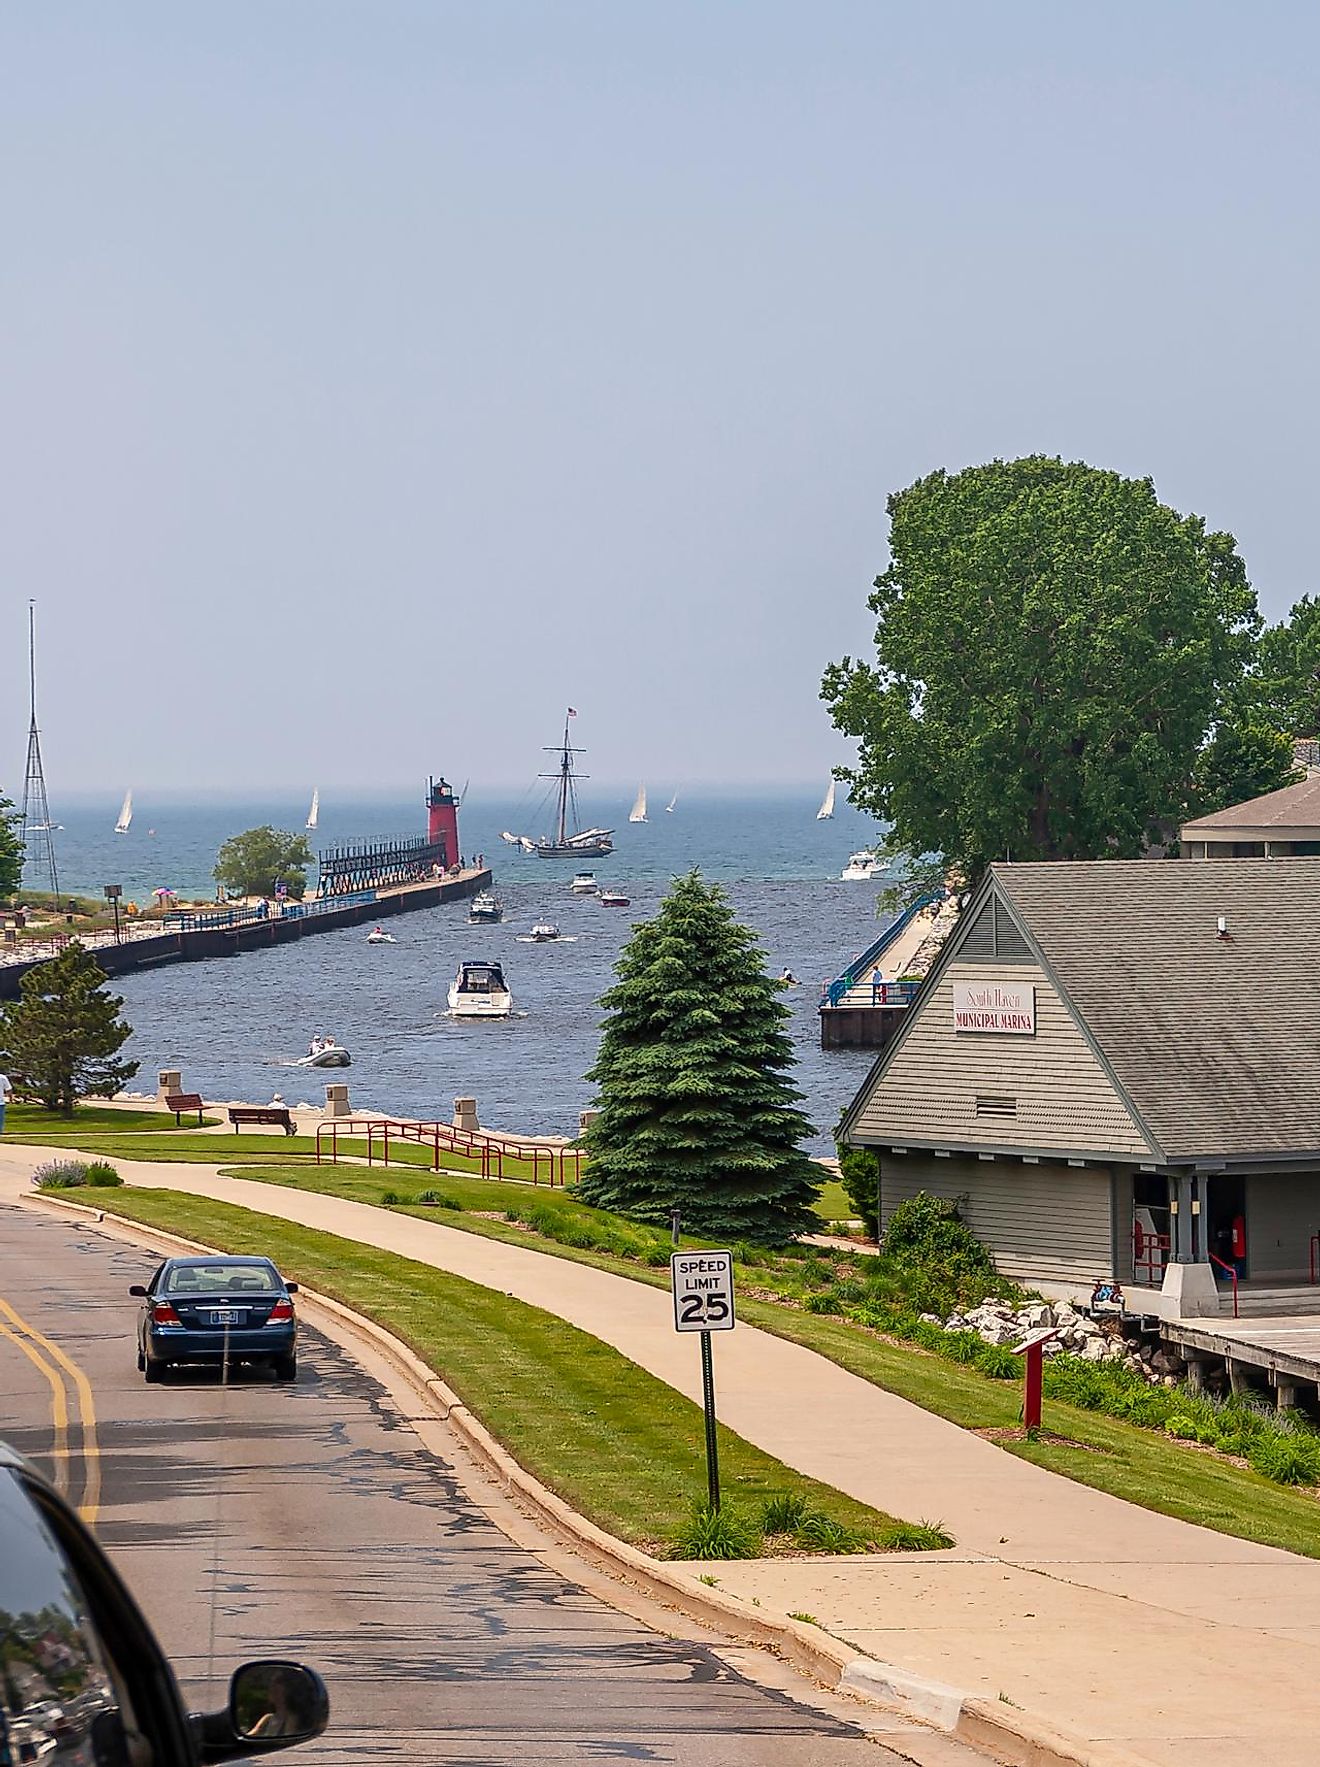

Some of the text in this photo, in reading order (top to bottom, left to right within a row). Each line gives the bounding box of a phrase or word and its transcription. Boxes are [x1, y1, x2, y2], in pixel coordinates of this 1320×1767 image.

[956, 1012, 1032, 1030] MUNICIPAL MARINA
[680, 1260, 726, 1273] SPEED
[685, 1277, 721, 1290] LIMIT
[680, 1293, 729, 1323] 25
